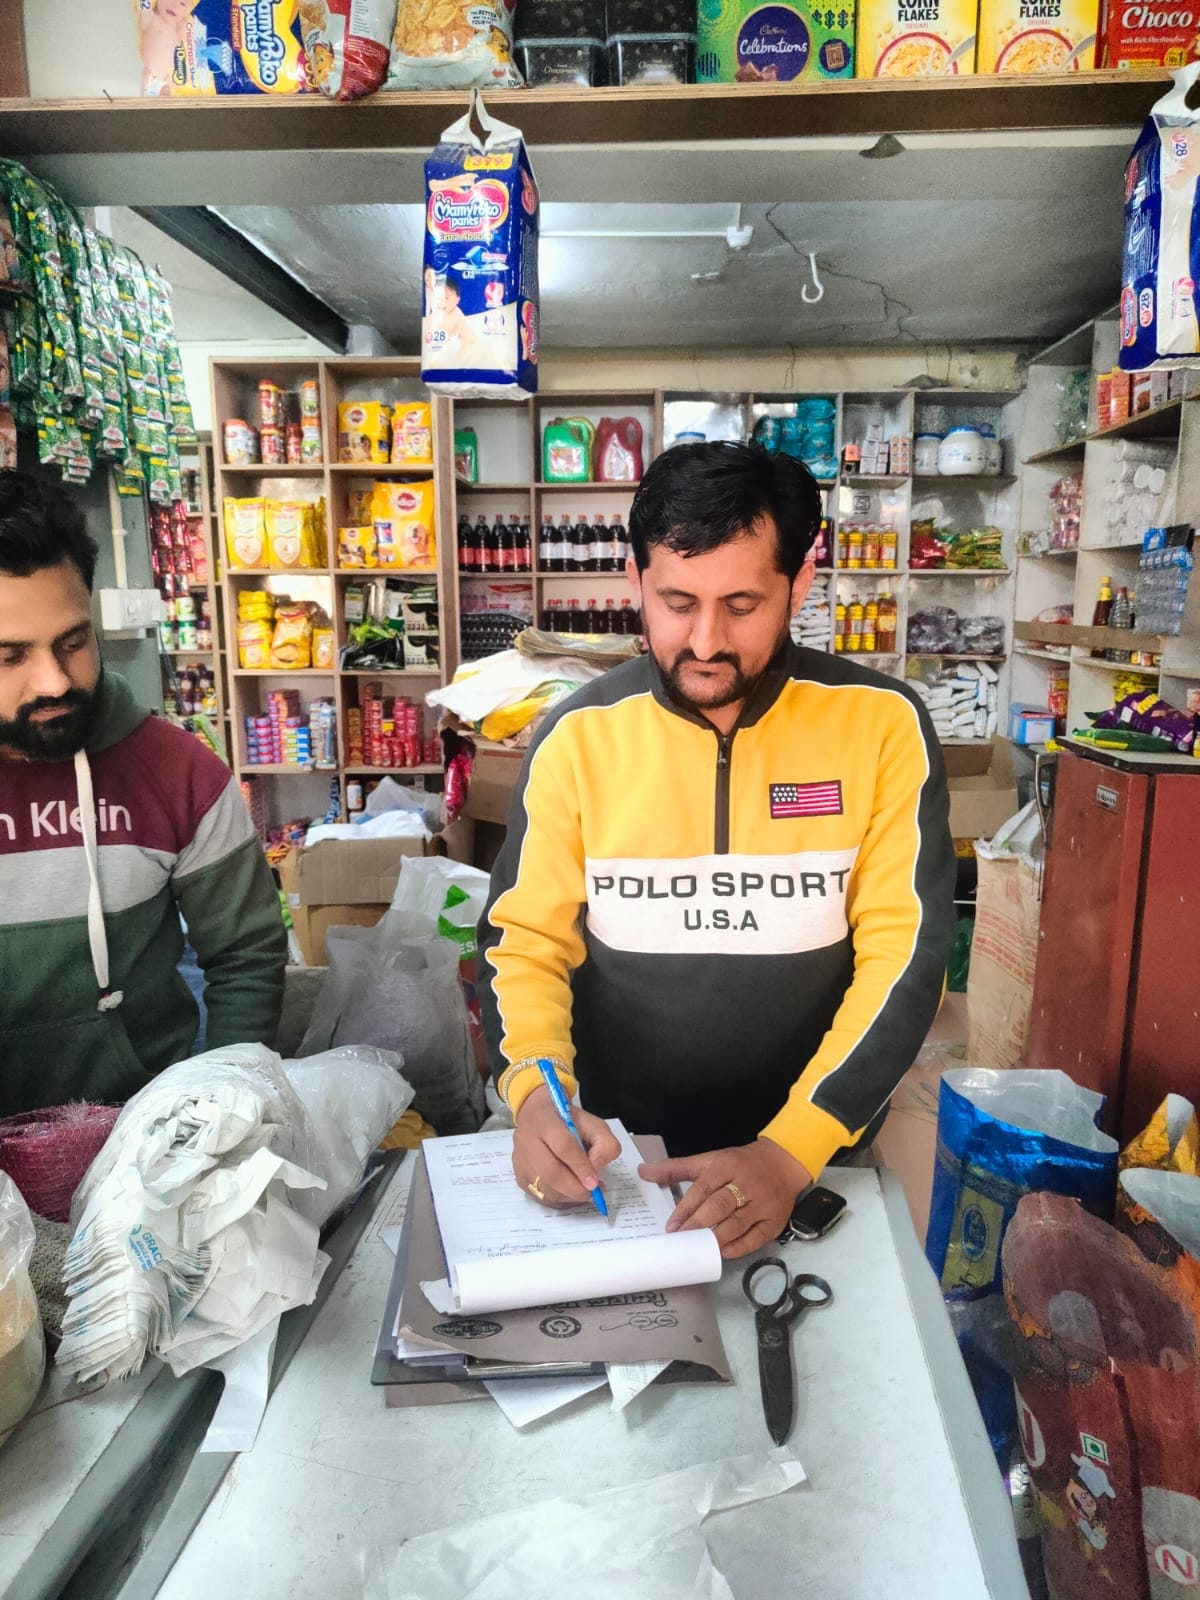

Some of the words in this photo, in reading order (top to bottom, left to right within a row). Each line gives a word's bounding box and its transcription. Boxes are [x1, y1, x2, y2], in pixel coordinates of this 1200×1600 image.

[898, 9, 939, 22] FLAKES
[1020, 6, 1061, 18] FLAKES
[1121, 6, 1193, 29] Choco
[232, 8, 241, 49] Standard
[241, 4, 259, 54] pants
[739, 37, 808, 55] Celebrations
[434, 193, 500, 221] MamyPoko
[452, 217, 479, 229] pants
[433, 331, 446, 341] 28
[30, 798, 132, 838] Klein
[592, 874, 697, 899] POLO
[712, 867, 851, 898] SPORT
[683, 909, 759, 931] U.S.A
